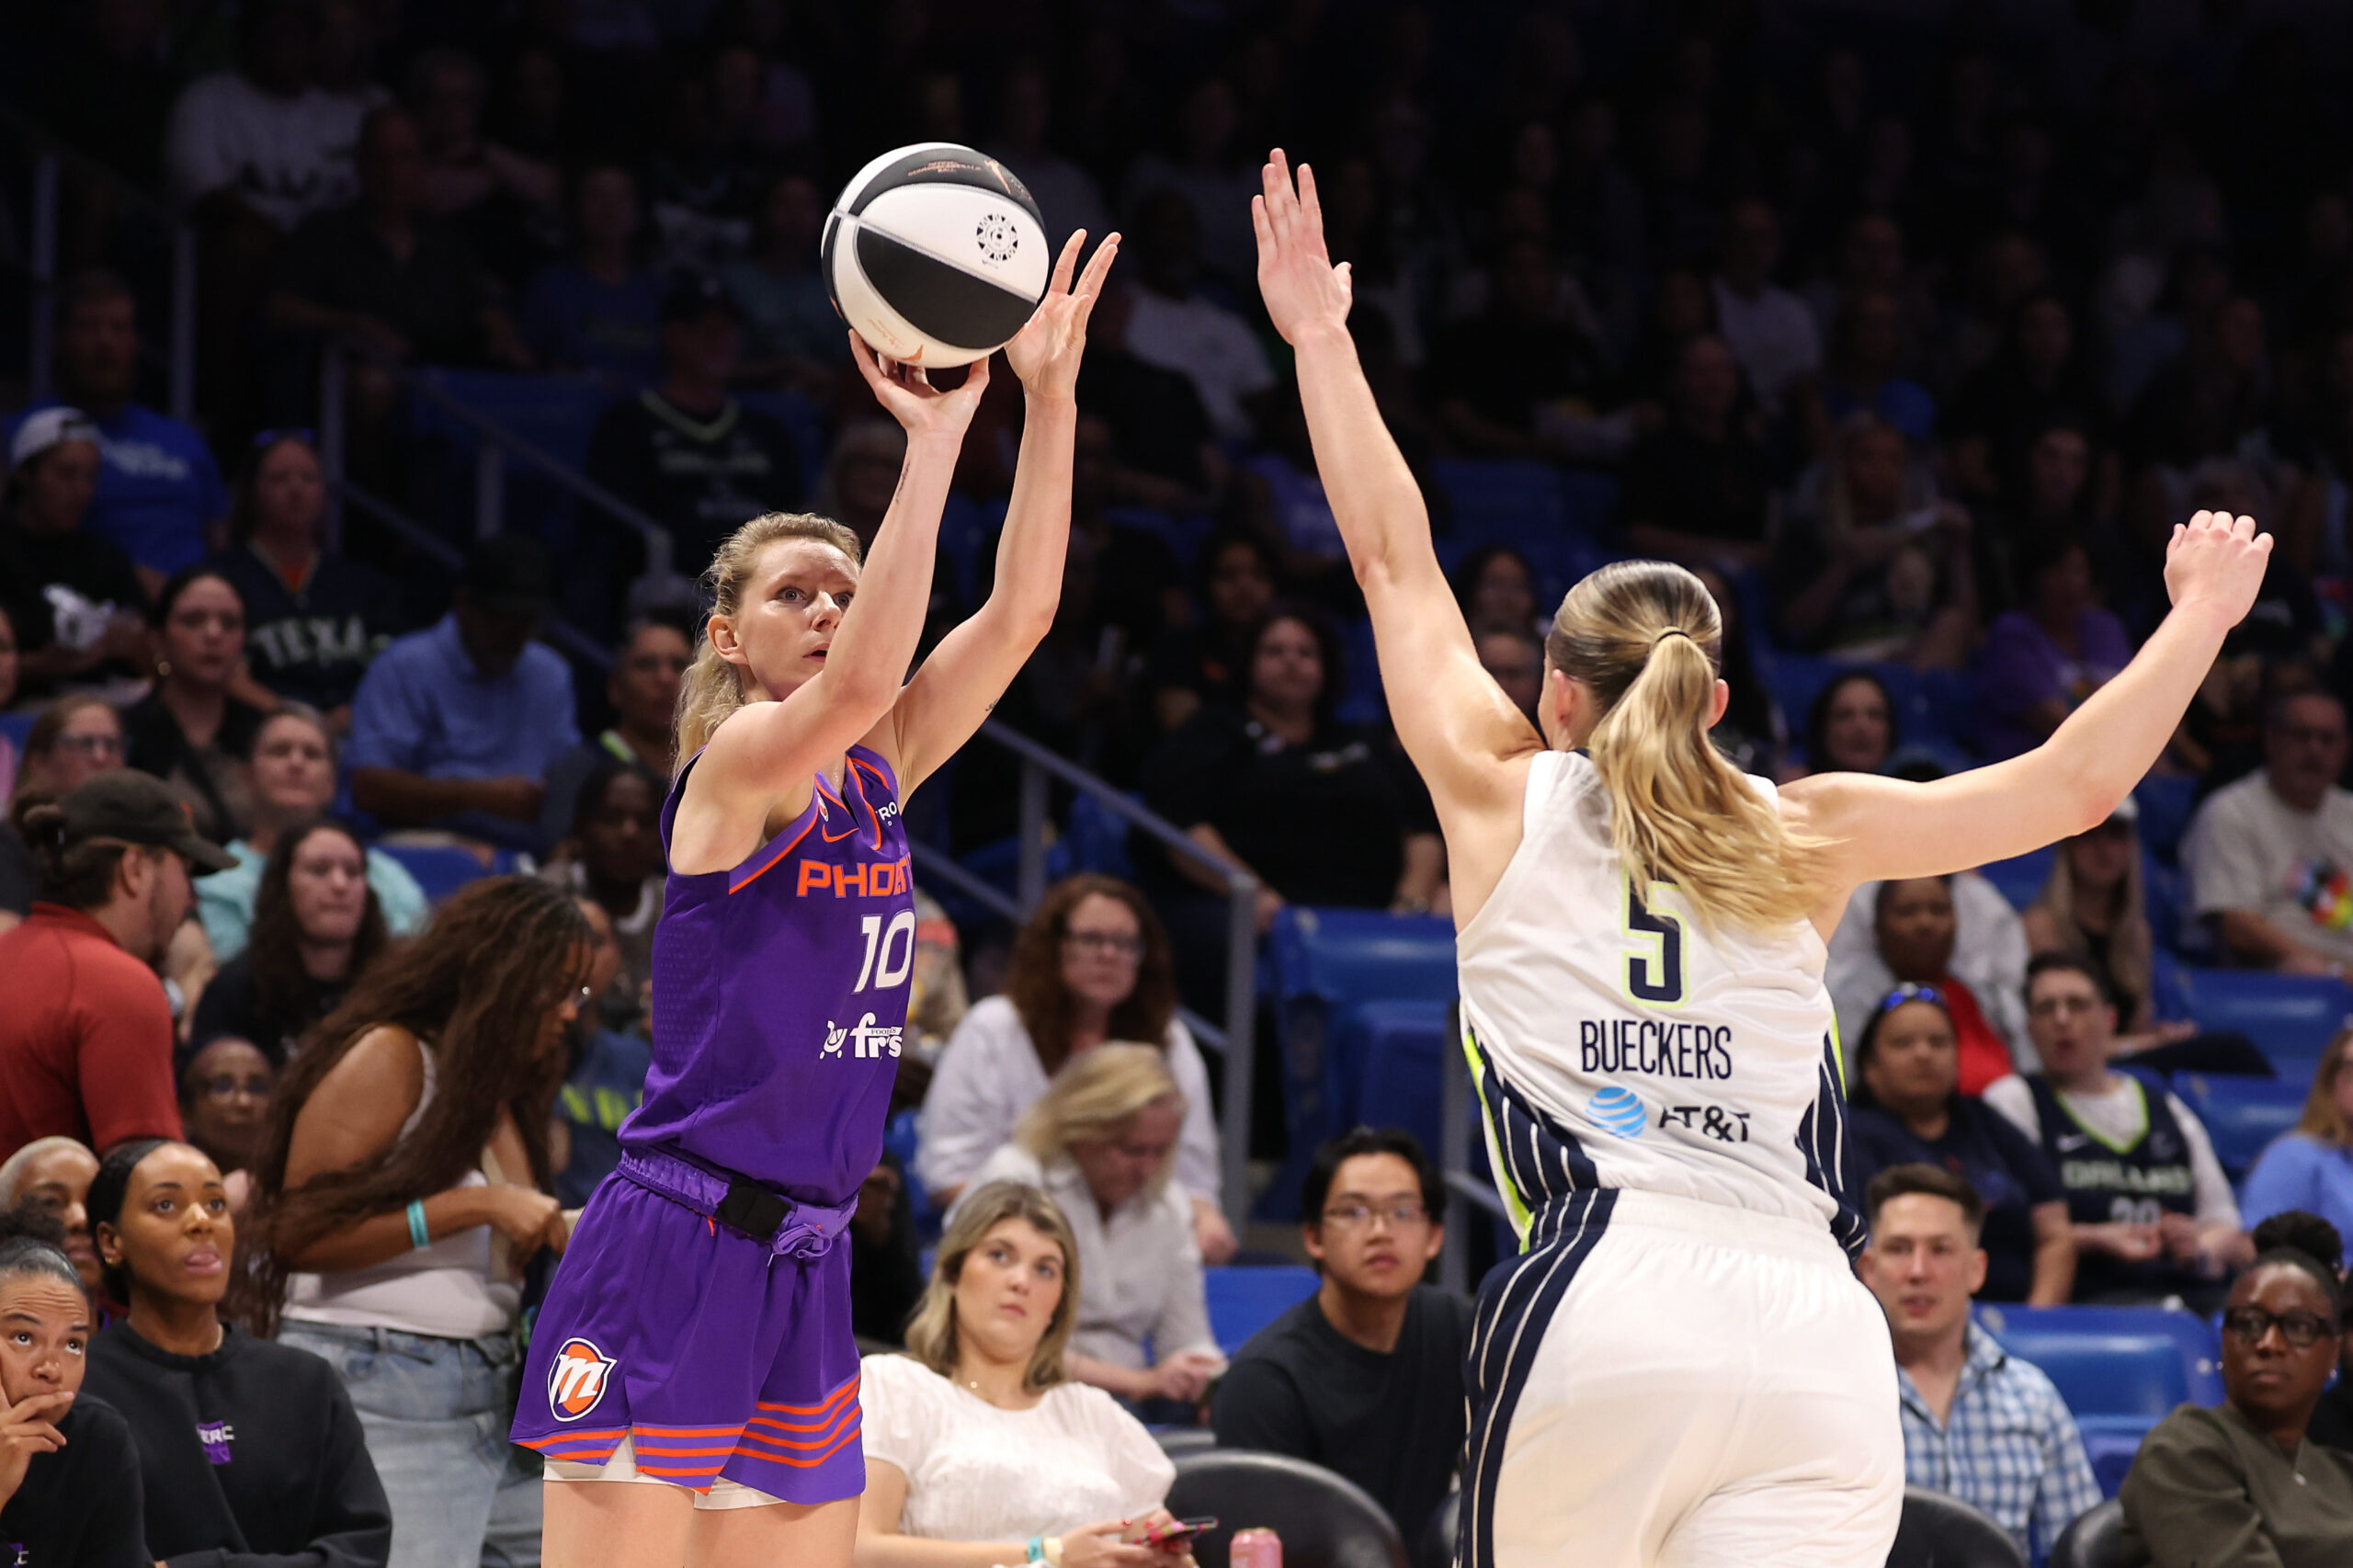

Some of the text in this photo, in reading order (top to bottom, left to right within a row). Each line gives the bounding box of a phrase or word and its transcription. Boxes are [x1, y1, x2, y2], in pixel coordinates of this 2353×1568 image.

[853, 908, 916, 995] 10
[1621, 864, 1689, 1009] 5
[1580, 1019, 1733, 1080] BUECKERS
[1658, 1105, 1750, 1142] AT&T
